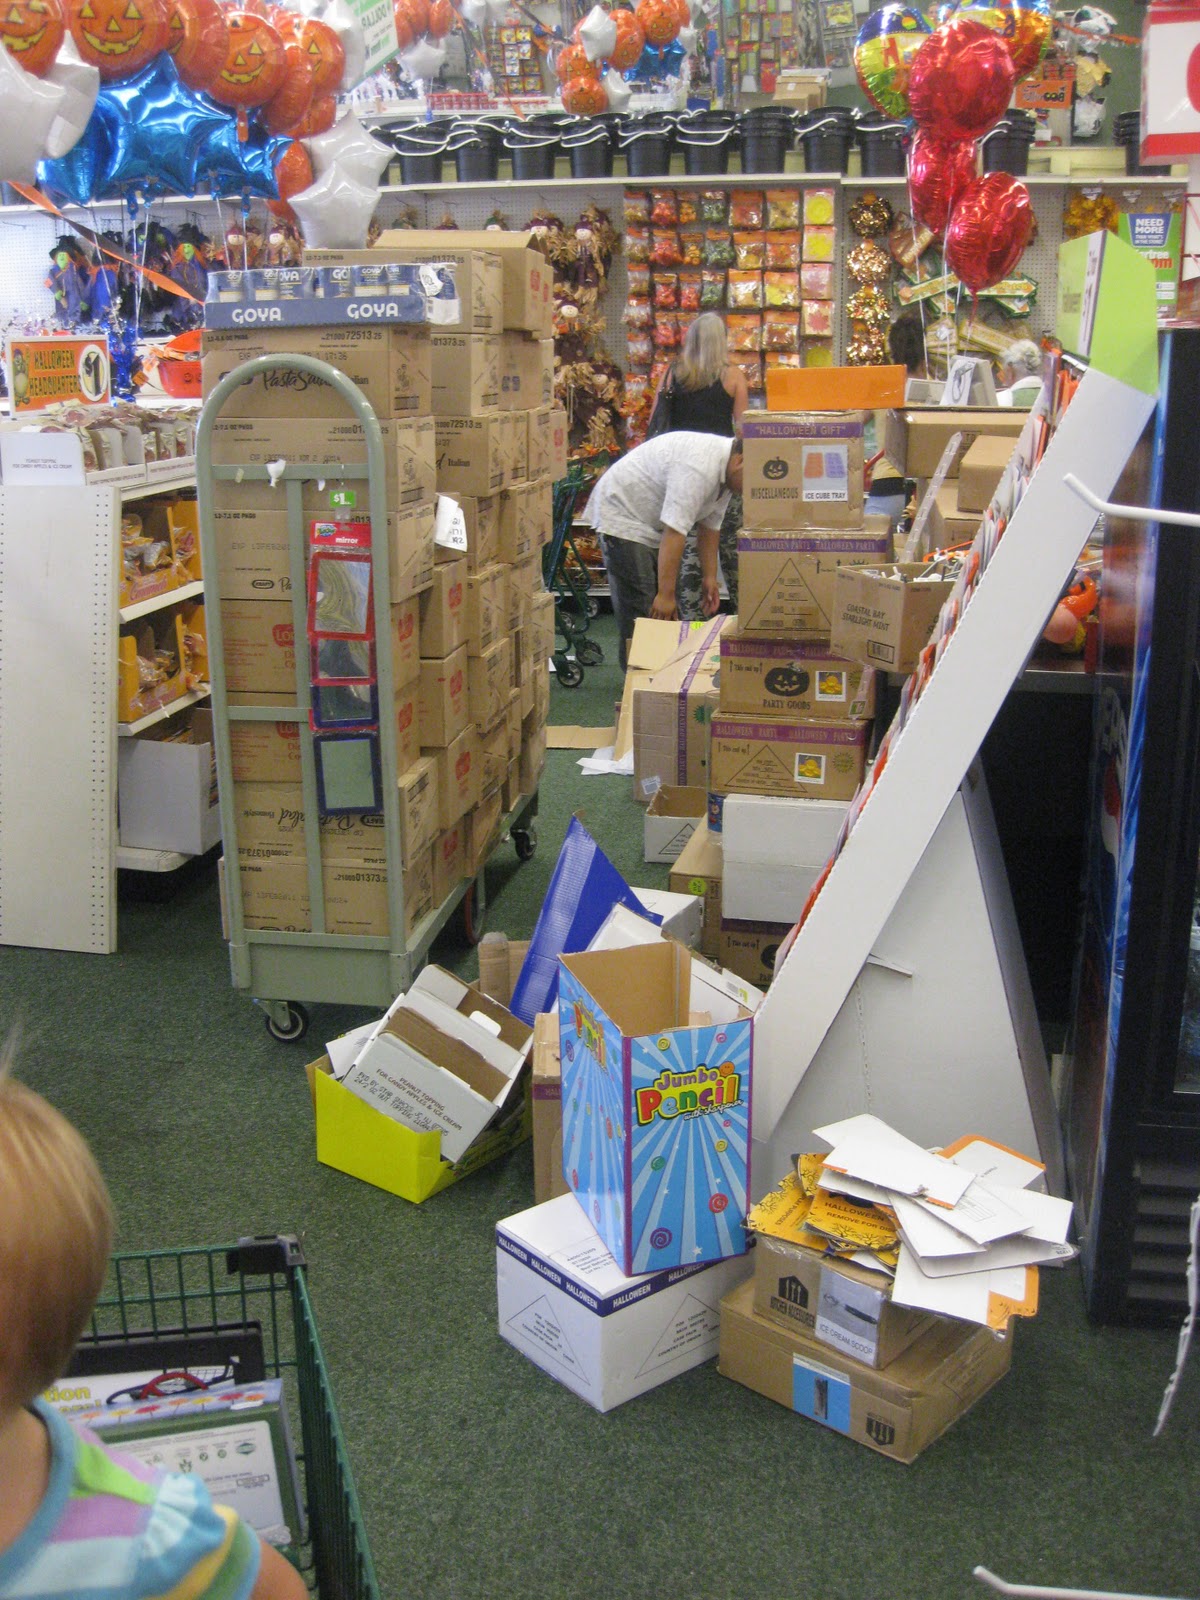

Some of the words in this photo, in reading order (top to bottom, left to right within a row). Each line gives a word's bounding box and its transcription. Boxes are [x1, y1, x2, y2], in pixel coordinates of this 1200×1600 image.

[1135, 226, 1164, 234] MORE
[1136, 218, 1164, 227] NEED
[232, 307, 282, 325] GOYA
[346, 302, 399, 320] GOYA
[34, 350, 75, 370] HALLOWEEN
[448, 458, 471, 468] Italian
[334, 492, 346, 505] $1
[751, 488, 799, 500] MISCELLANEOUS
[805, 492, 815, 500] ICE
[816, 492, 831, 500] CUBE
[335, 536, 359, 544] mirror
[751, 540, 789, 550] HALLOWEEN
[815, 540, 855, 551] HALLOWEEN
[856, 541, 876, 551] PARTY
[846, 603, 872, 617] COASTAL
[872, 609, 886, 620] BAY
[842, 612, 872, 627] STARLIGHT
[872, 618, 890, 632] MINT
[763, 700, 785, 709] PARTY
[788, 700, 811, 710] GOODS
[716, 725, 754, 737] HALLOWEEN
[788, 729, 828, 742] HALLOWEEN
[370, 1079, 379, 1088] BY
[657, 1070, 718, 1091] Jumbo
[376, 1068, 388, 1080] FOR
[388, 1076, 407, 1092] CANDY
[406, 1089, 426, 1107] APPLES
[433, 1108, 443, 1118] ICE
[442, 1114, 463, 1131] CREAM
[400, 1077, 422, 1095] PEANUT
[422, 1090, 445, 1112] TOPPING
[640, 1076, 737, 1121] Pencil
[390, 1100, 414, 1120] TOPPING
[684, 1108, 702, 1121] with
[703, 1099, 744, 1115] sharpener
[824, 1202, 885, 1222] HALLOWEEN
[826, 1211, 860, 1225] REMOVE
[862, 1220, 879, 1230] FOR
[498, 1236, 528, 1263] HALLOWEEN
[530, 1258, 562, 1285] HALLOWEEN
[566, 1281, 598, 1310] HALLOWEEN
[612, 1283, 651, 1309] HALLOWEEN
[770, 1296, 788, 1315] KITCHEN
[820, 1324, 830, 1333] ICE
[830, 1329, 851, 1344] CREAM
[852, 1340, 873, 1354] SCOOP
